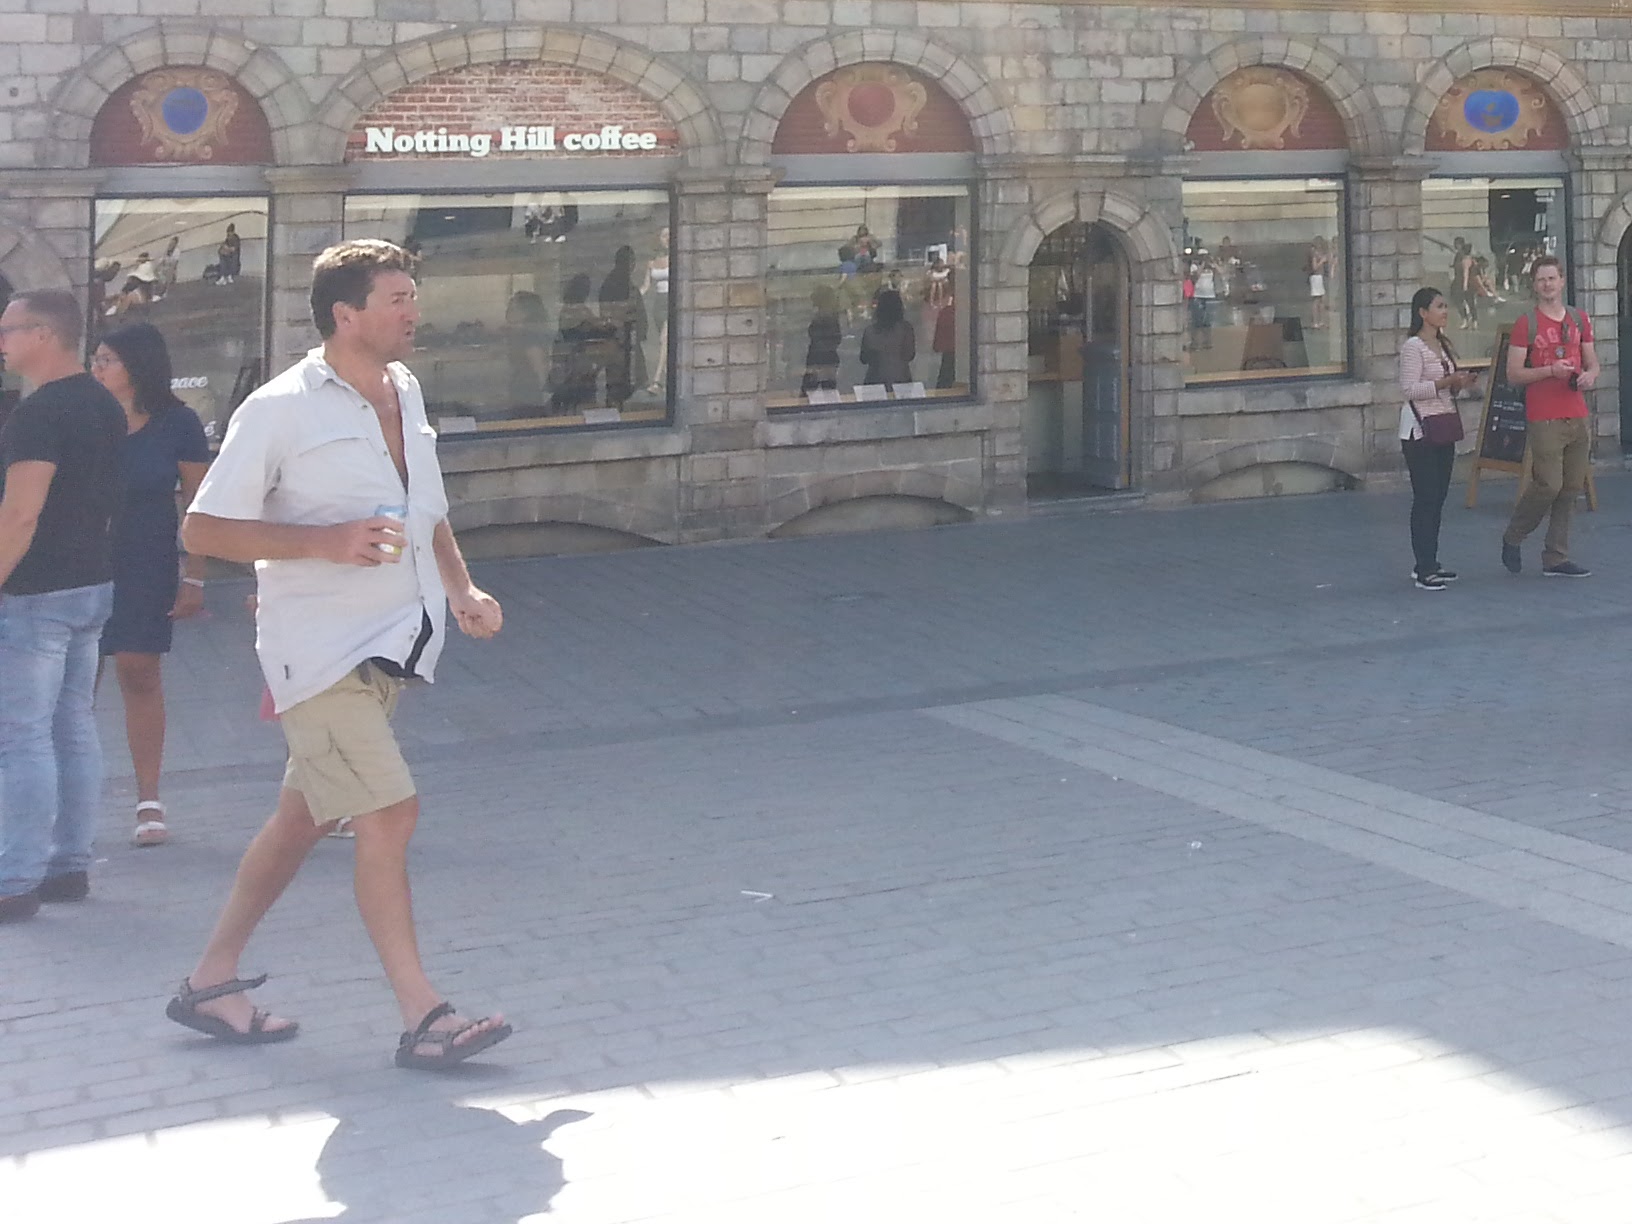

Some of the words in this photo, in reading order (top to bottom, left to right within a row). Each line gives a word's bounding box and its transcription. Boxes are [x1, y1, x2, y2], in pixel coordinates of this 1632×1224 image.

[365, 127, 492, 157] Notting
[500, 126, 556, 151] Hill
[563, 126, 657, 151] coffee
